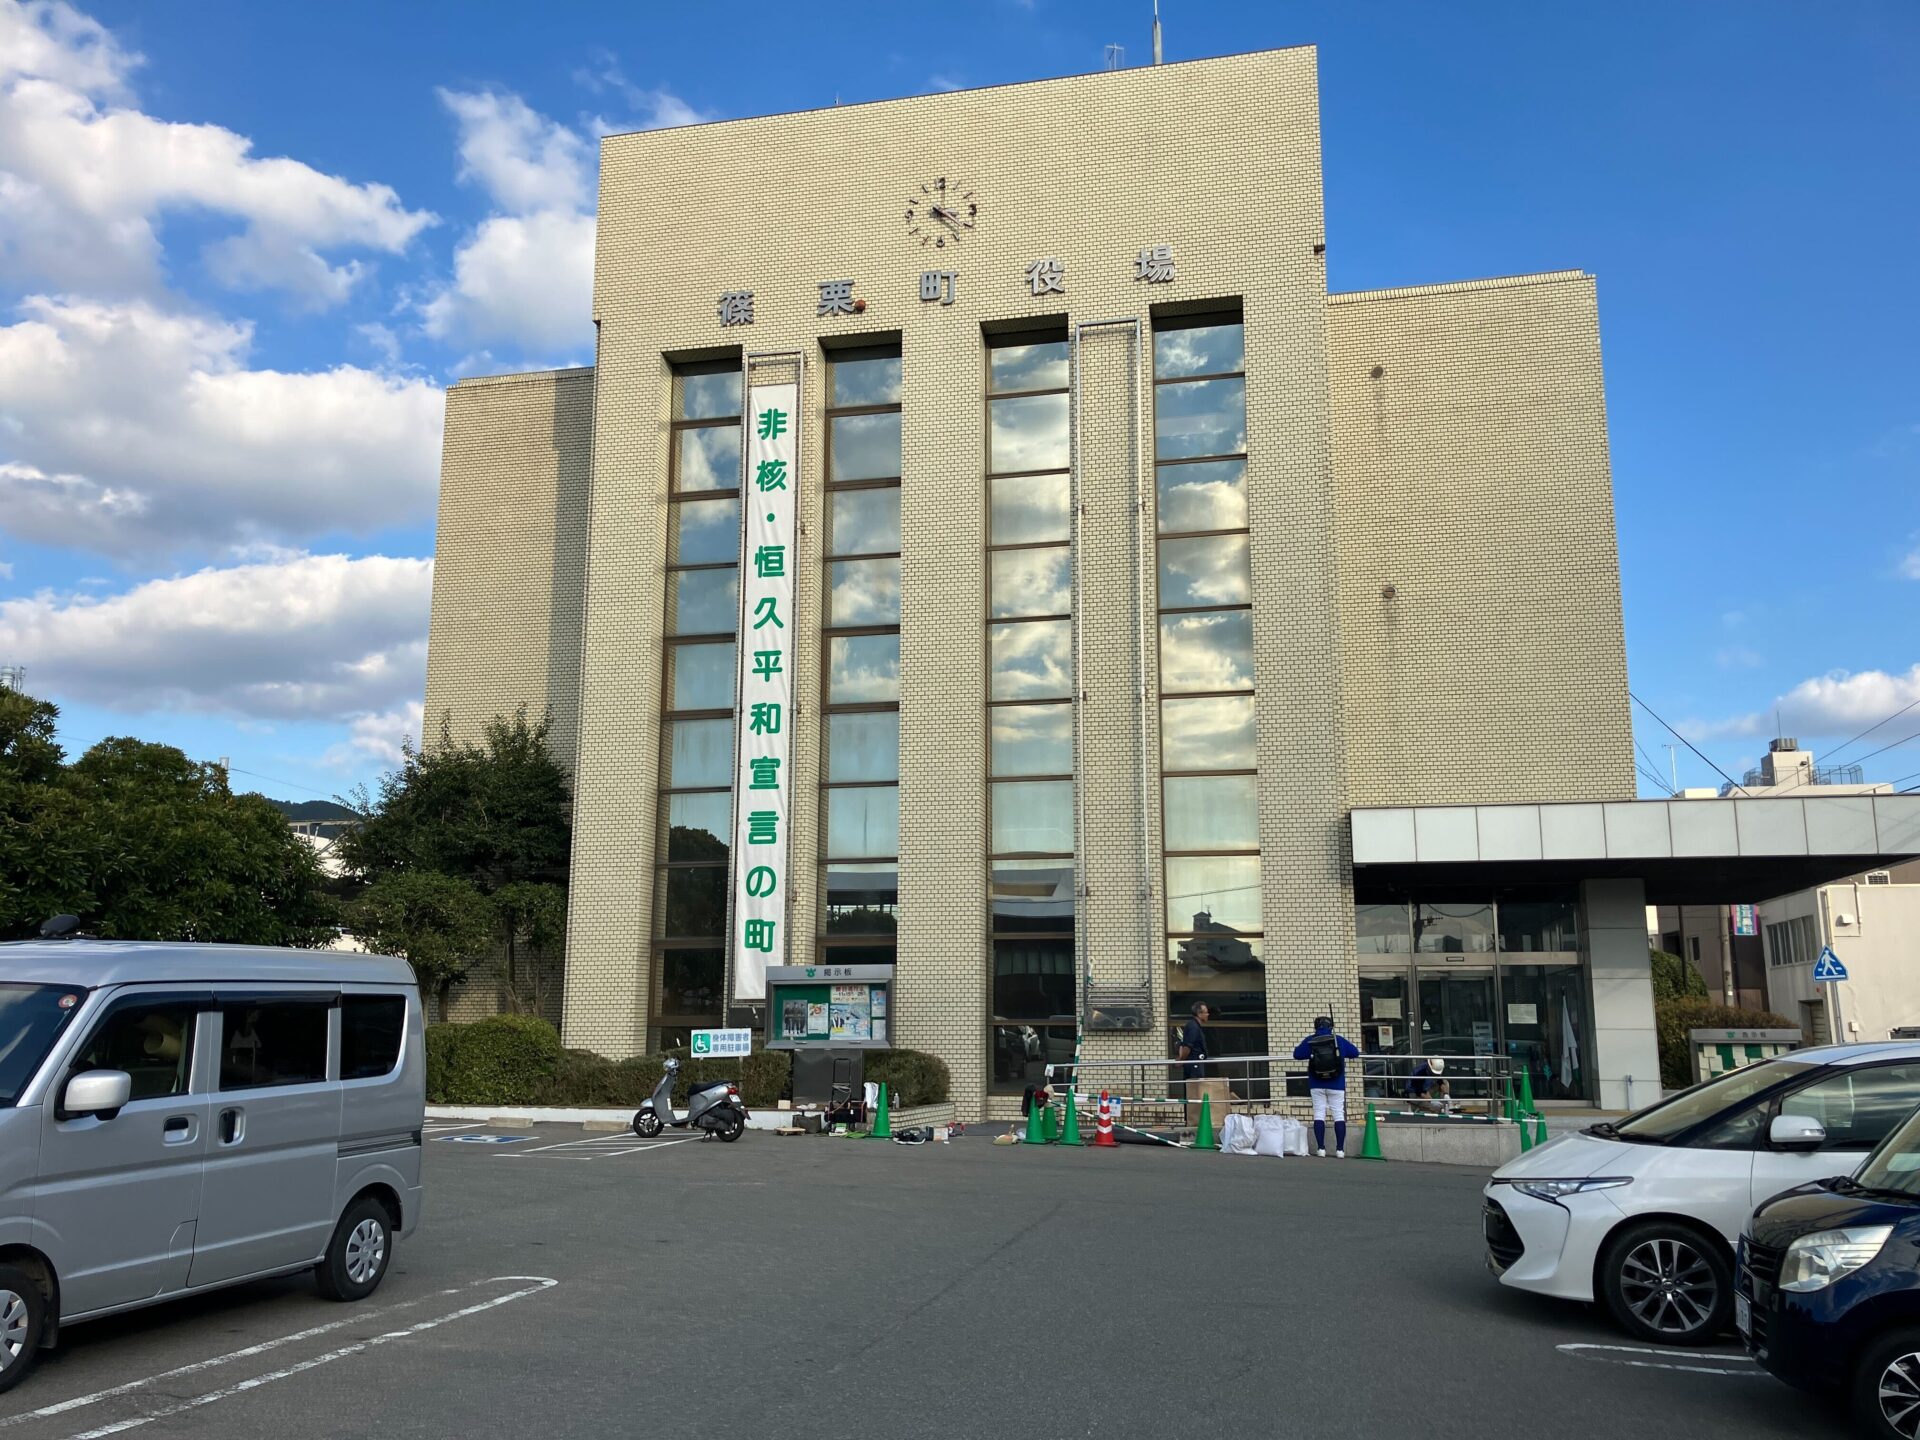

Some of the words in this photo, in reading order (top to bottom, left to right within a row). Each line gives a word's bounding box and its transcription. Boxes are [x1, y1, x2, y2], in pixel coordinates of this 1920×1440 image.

[719, 245, 1175, 326] 篠栗町役場
[744, 408, 788, 953] 非核・恒久平和宣言の町
